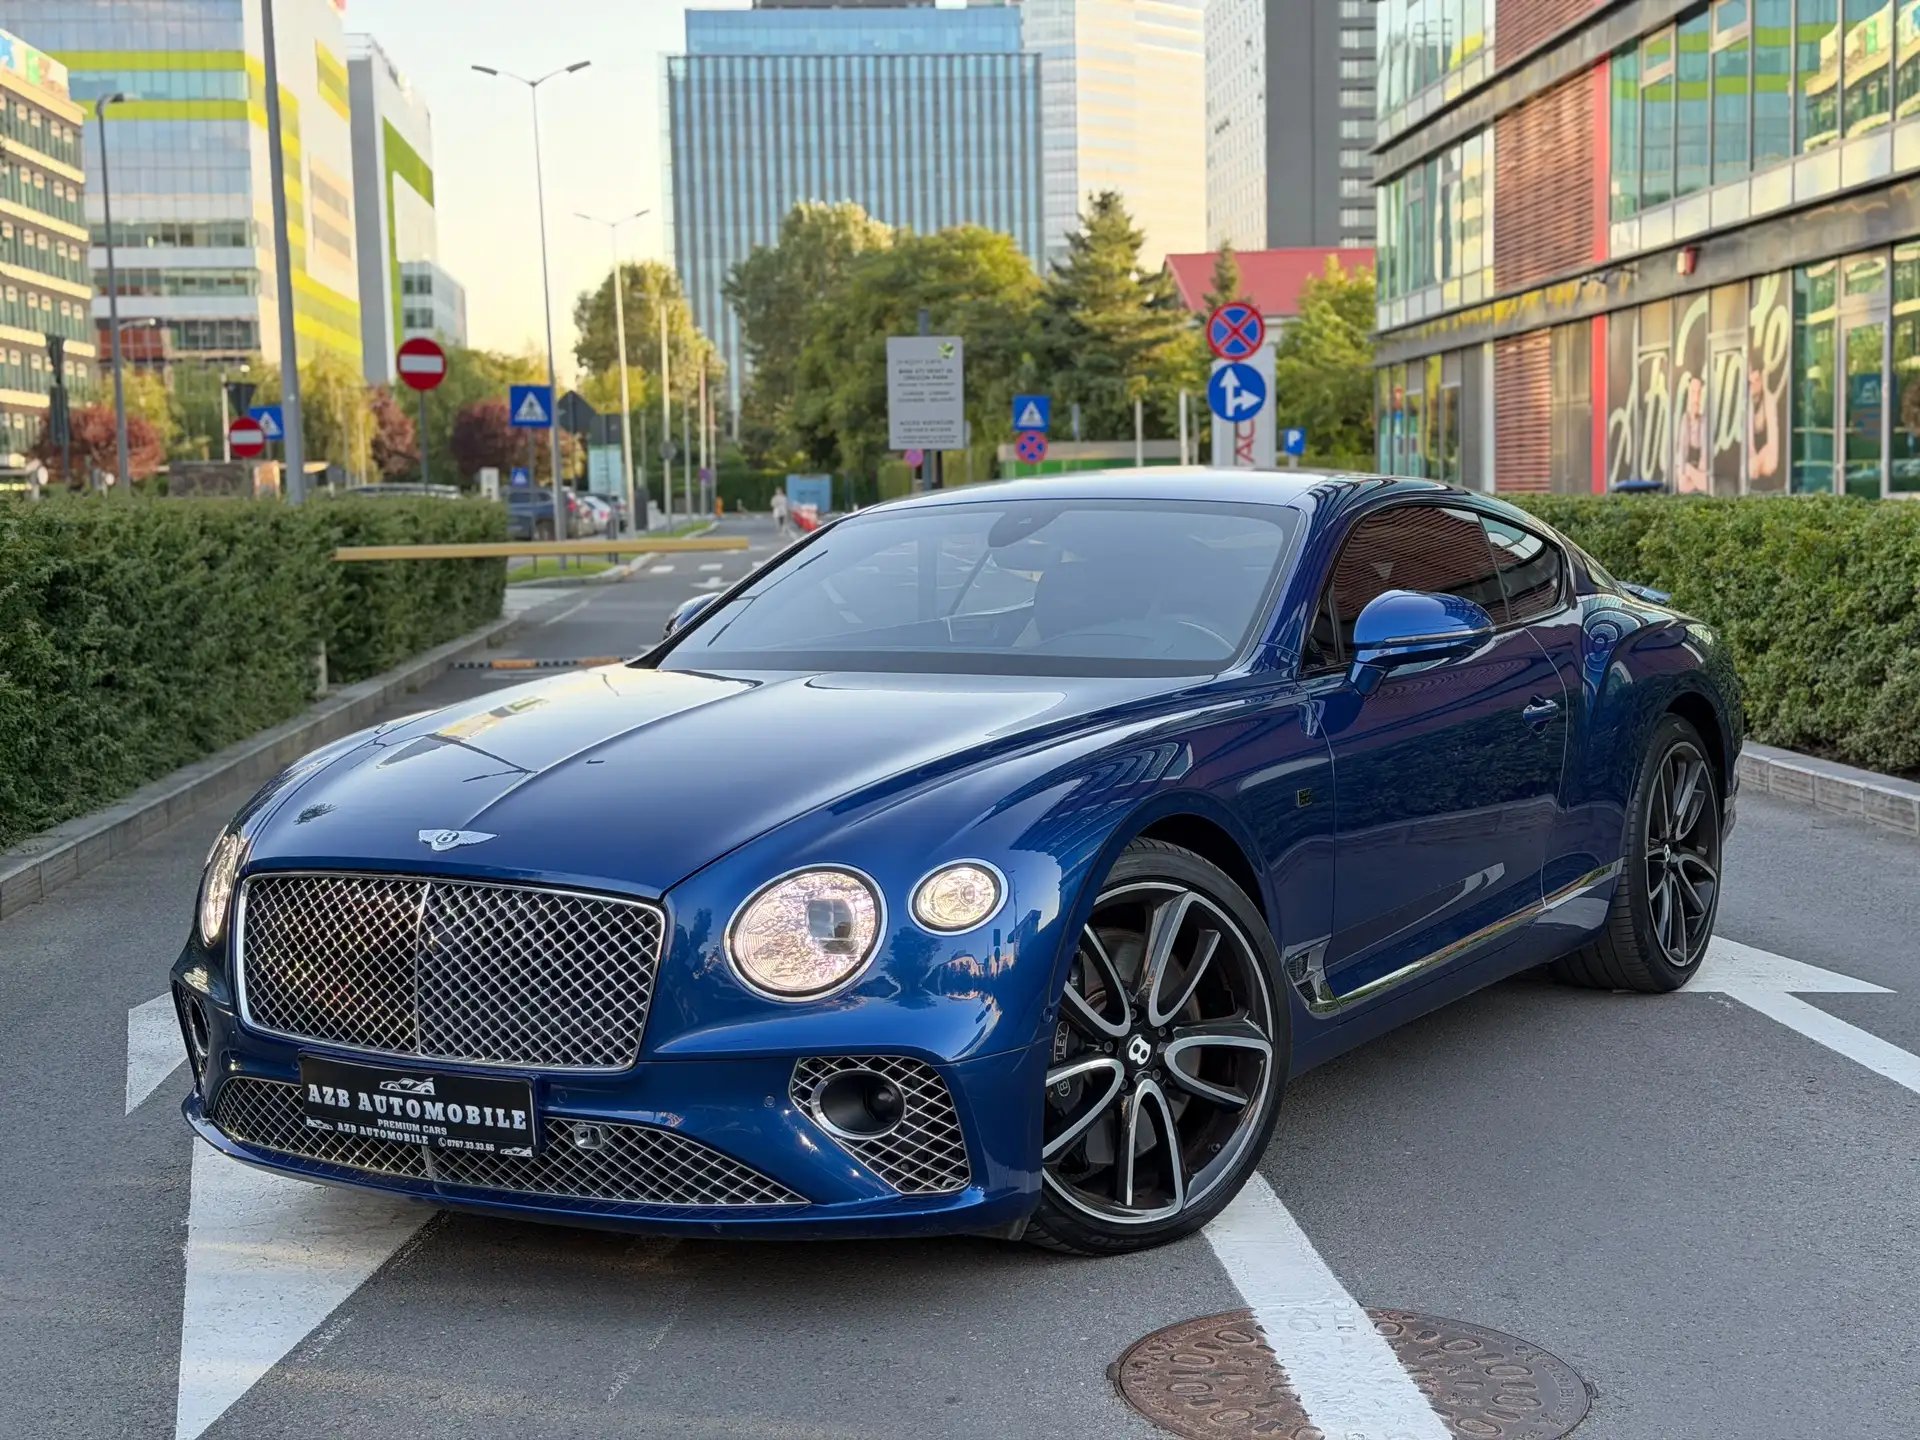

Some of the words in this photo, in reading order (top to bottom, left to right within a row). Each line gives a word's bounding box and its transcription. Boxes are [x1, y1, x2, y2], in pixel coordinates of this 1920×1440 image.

[1288, 430, 1302, 447] P
[308, 1084, 350, 1108] AZB
[358, 1092, 526, 1130] AUTOMOBILE
[337, 1122, 357, 1134] AZB
[360, 1126, 429, 1145] AUTOMOBILE
[377, 1119, 420, 1133] PREMIUM
[422, 1125, 447, 1136] CARS
